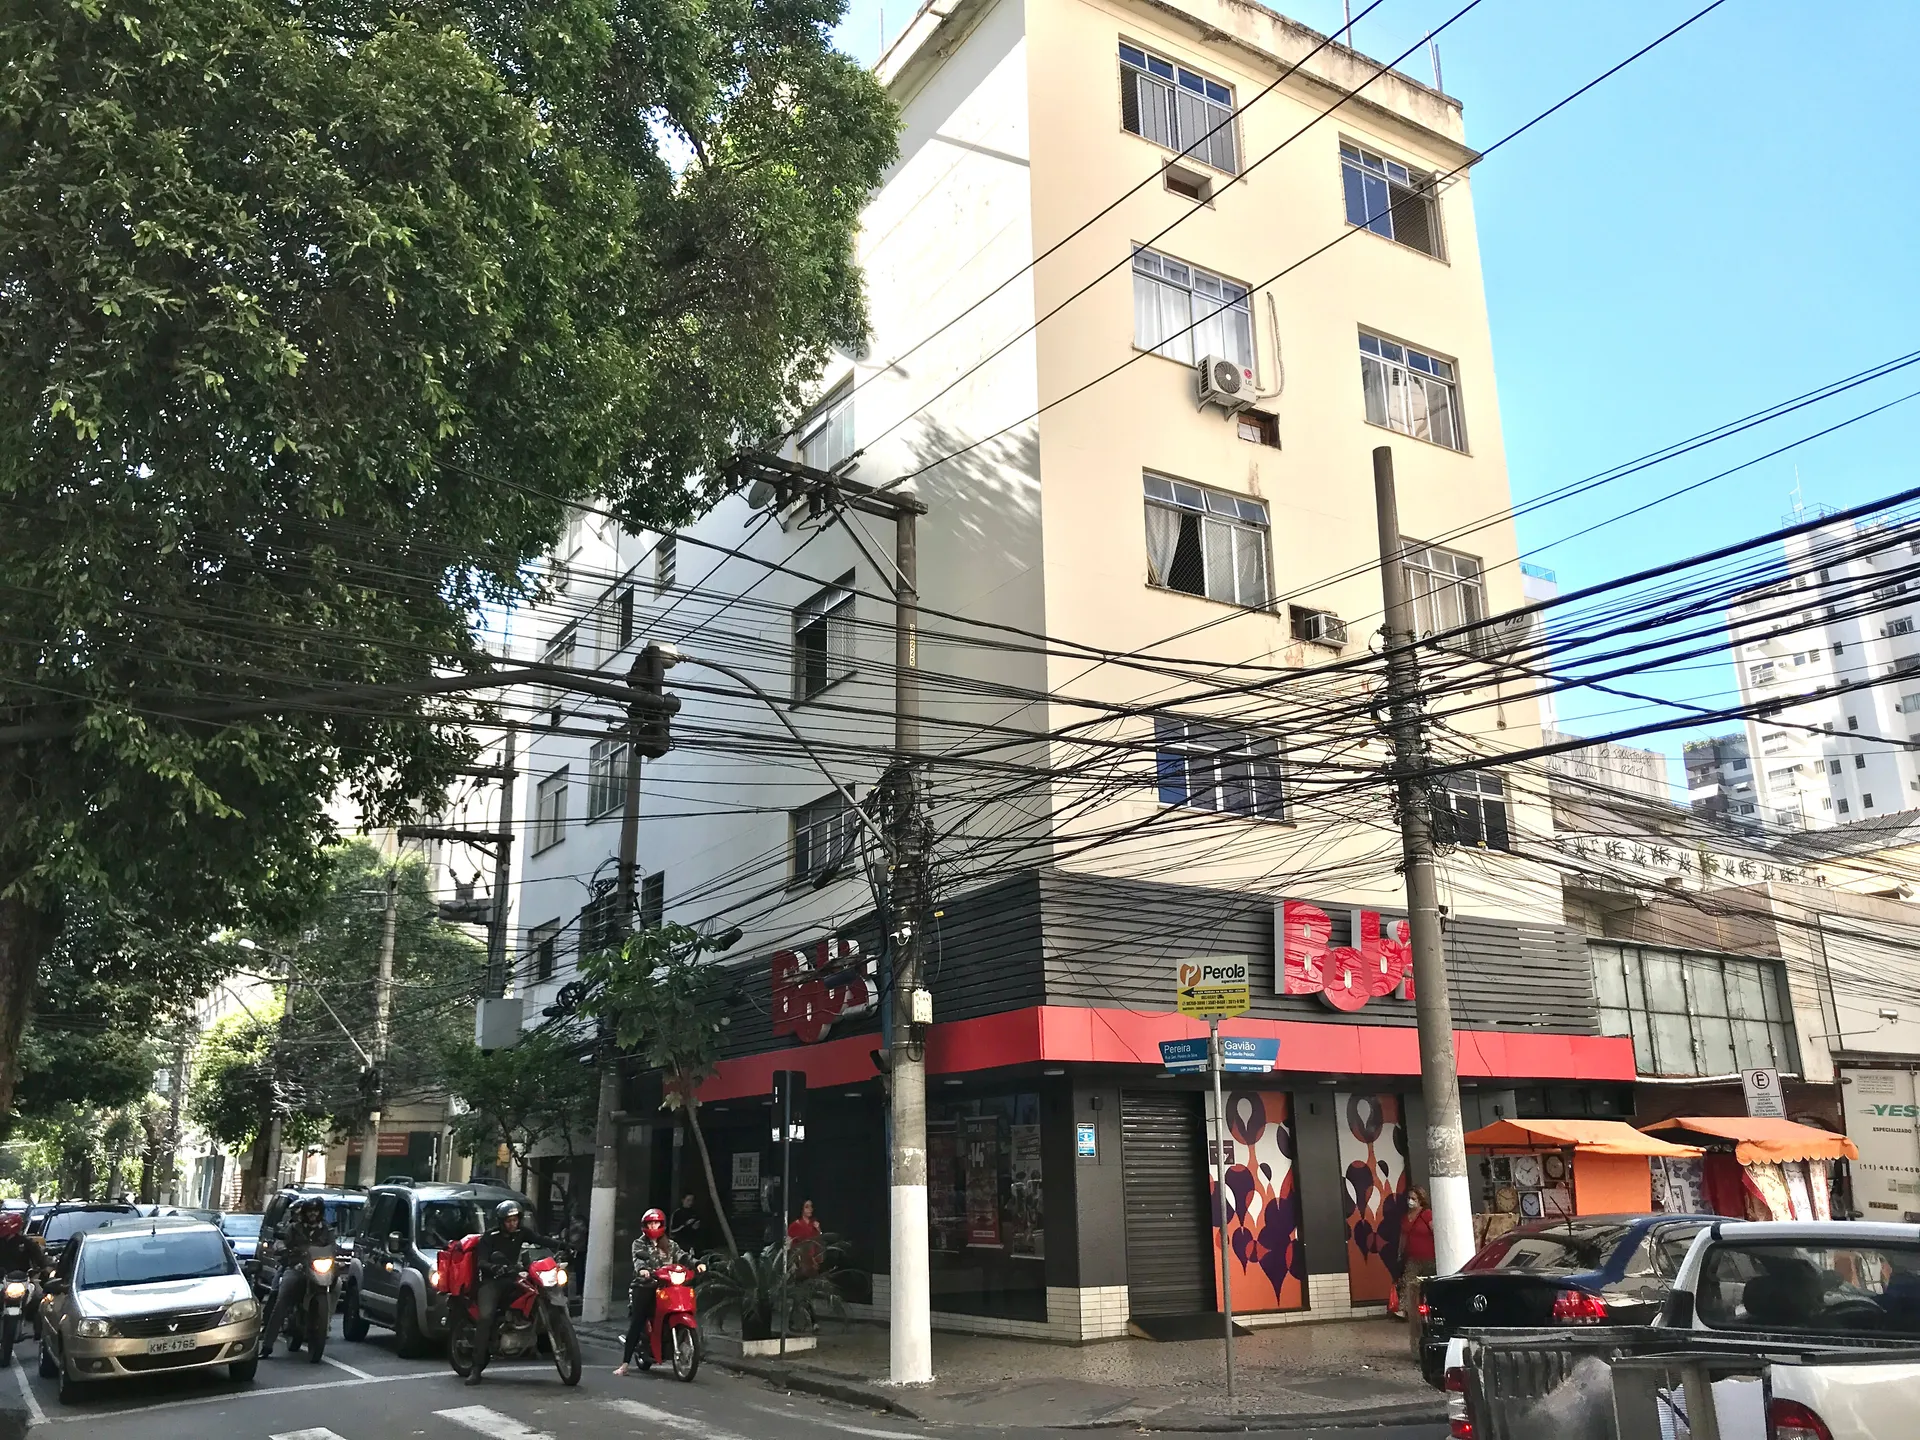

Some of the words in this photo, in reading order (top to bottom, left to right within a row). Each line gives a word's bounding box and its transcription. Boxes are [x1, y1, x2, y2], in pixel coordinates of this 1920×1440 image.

[1203, 964, 1245, 980] Perola
[1164, 1043, 1191, 1054] Pereira
[1224, 1040, 1256, 1051] Gavião
[1756, 1074, 1765, 1086] E
[1872, 1126, 1912, 1134] ESPECIALIZADO
[1859, 1163, 1877, 1171] (11)
